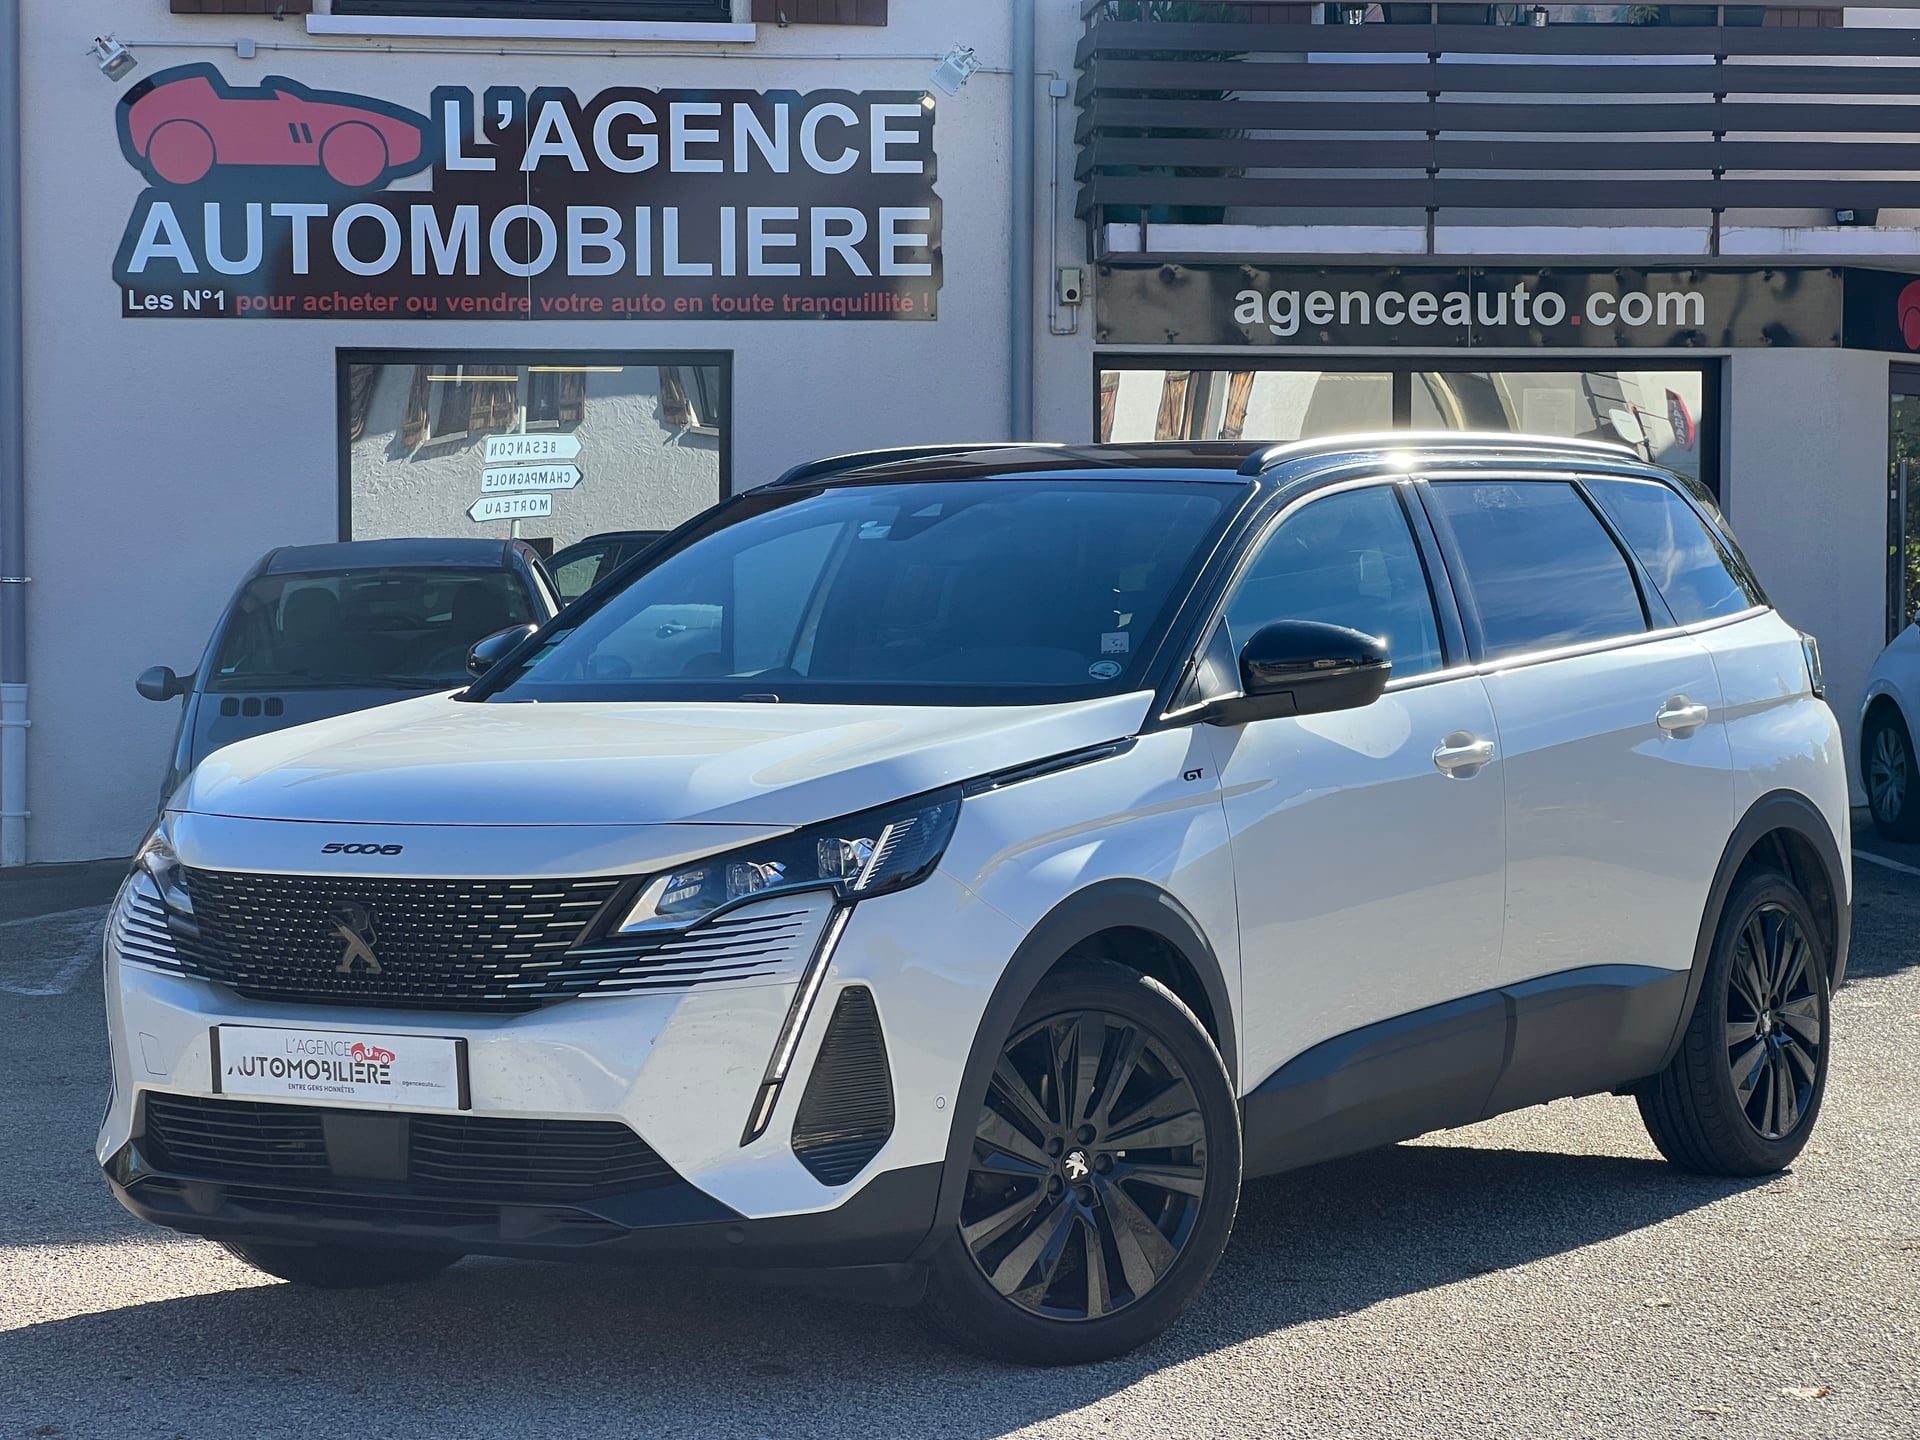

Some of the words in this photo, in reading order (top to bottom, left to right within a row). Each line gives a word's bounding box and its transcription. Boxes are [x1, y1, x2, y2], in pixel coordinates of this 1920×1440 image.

[126, 202, 933, 278] AUTOMOBILIERE
[128, 289, 174, 311] Les
[183, 289, 225, 311] N°1
[235, 293, 295, 316] pour
[303, 291, 399, 312] acheter
[406, 296, 438, 312] ou
[444, 292, 531, 313] vendre
[540, 293, 604, 313] votre
[611, 293, 666, 313] auto
[674, 296, 703, 313] en
[711, 292, 772, 313] toute
[782, 291, 914, 317] tranquillité
[923, 292, 929, 313] !
[1233, 282, 1706, 337] agenceauto.com
[1183, 768, 1204, 782] GT
[321, 843, 404, 856] 5008
[288, 1083, 306, 1092] ENTRE
[307, 1084, 323, 1092] GENS
